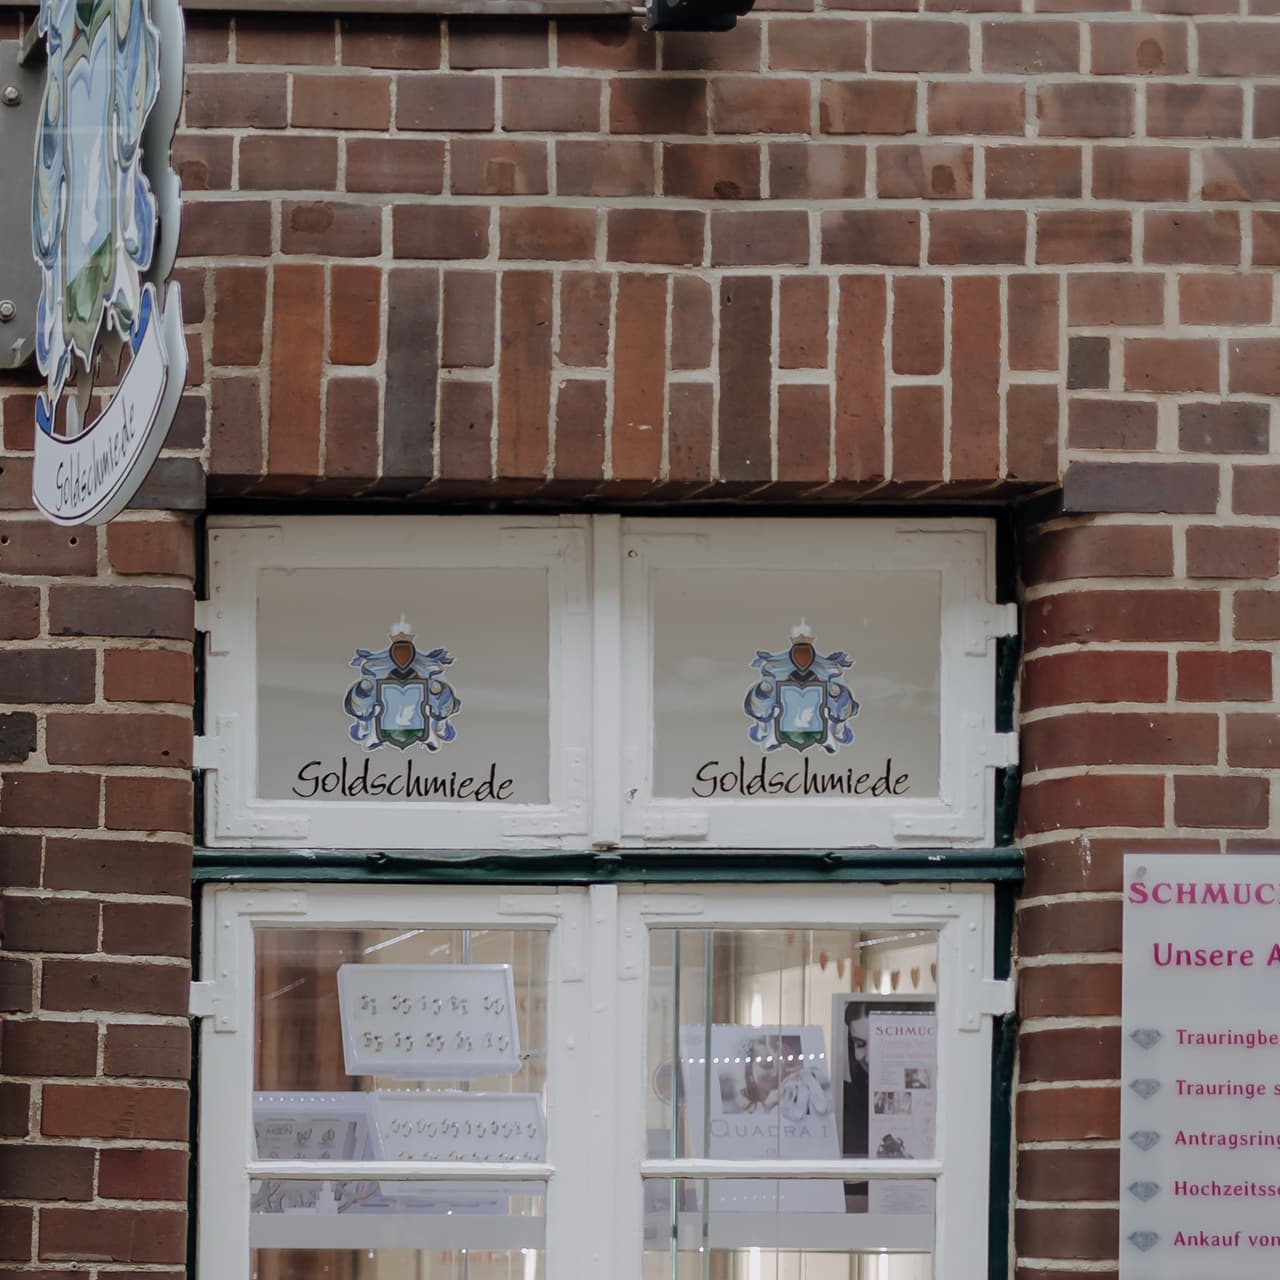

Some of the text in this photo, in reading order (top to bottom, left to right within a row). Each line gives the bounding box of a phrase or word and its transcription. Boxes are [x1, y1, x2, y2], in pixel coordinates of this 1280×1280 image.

[56, 396, 135, 511] Goldschmiede
[292, 756, 514, 801] Goldschmiede
[691, 756, 910, 797] Goldschmiede
[1129, 882, 1280, 904] SCHMUC
[1153, 943, 1254, 967] Unsere
[1176, 1029, 1279, 1049] Trauringbe
[1176, 1080, 1266, 1099] Trauringe
[1174, 1231, 1280, 1247] Ankauf von
